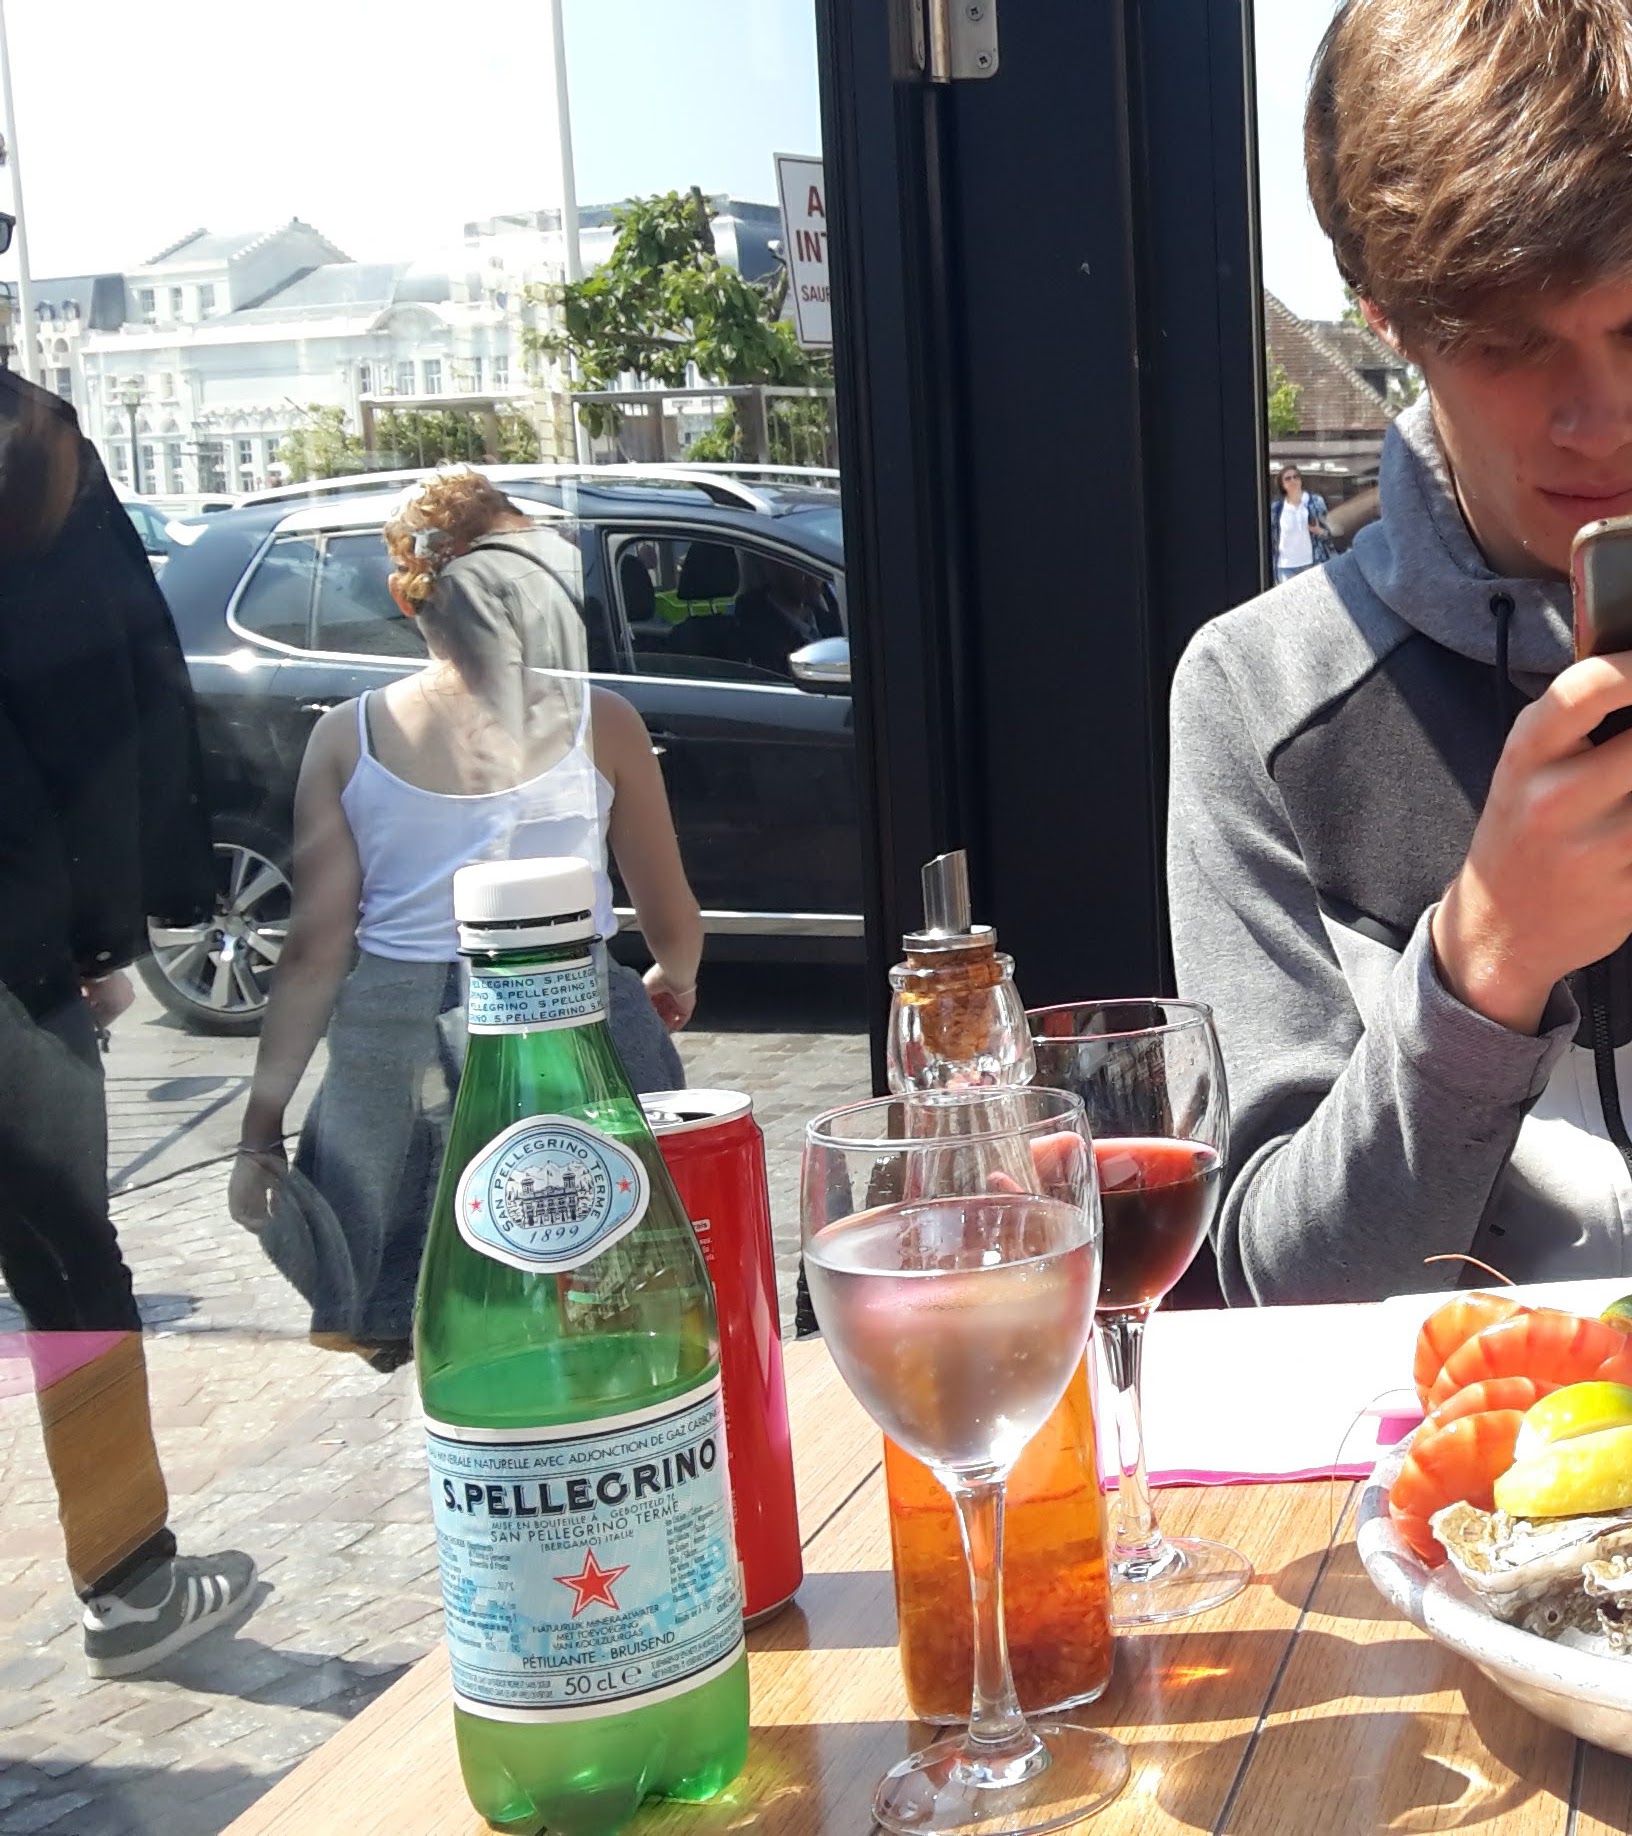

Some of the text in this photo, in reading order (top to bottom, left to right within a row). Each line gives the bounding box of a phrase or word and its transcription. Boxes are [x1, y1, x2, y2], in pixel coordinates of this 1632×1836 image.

[496, 982, 585, 1000] S.PELLEGRINO
[494, 1005, 585, 1023] S.PELLEGRINO
[494, 1138, 606, 1232] SAN PELLEGRINO TERME
[529, 1225, 580, 1245] 1899
[474, 1458, 529, 1470] NATURELLE
[533, 1455, 565, 1468] AVEC
[569, 1438, 648, 1465] ADJONCTION
[650, 1433, 665, 1447] DE
[666, 1424, 687, 1441] GAZ
[442, 1437, 718, 1517] S.PELLEGRINO
[490, 1530, 521, 1543] SAN
[528, 1517, 628, 1543] PELLEGRINO
[635, 1500, 680, 1525] TERME
[522, 1651, 597, 1670] PÉTILLANTE
[610, 1631, 675, 1660] BRUISEND
[564, 1675, 592, 1697] 50
